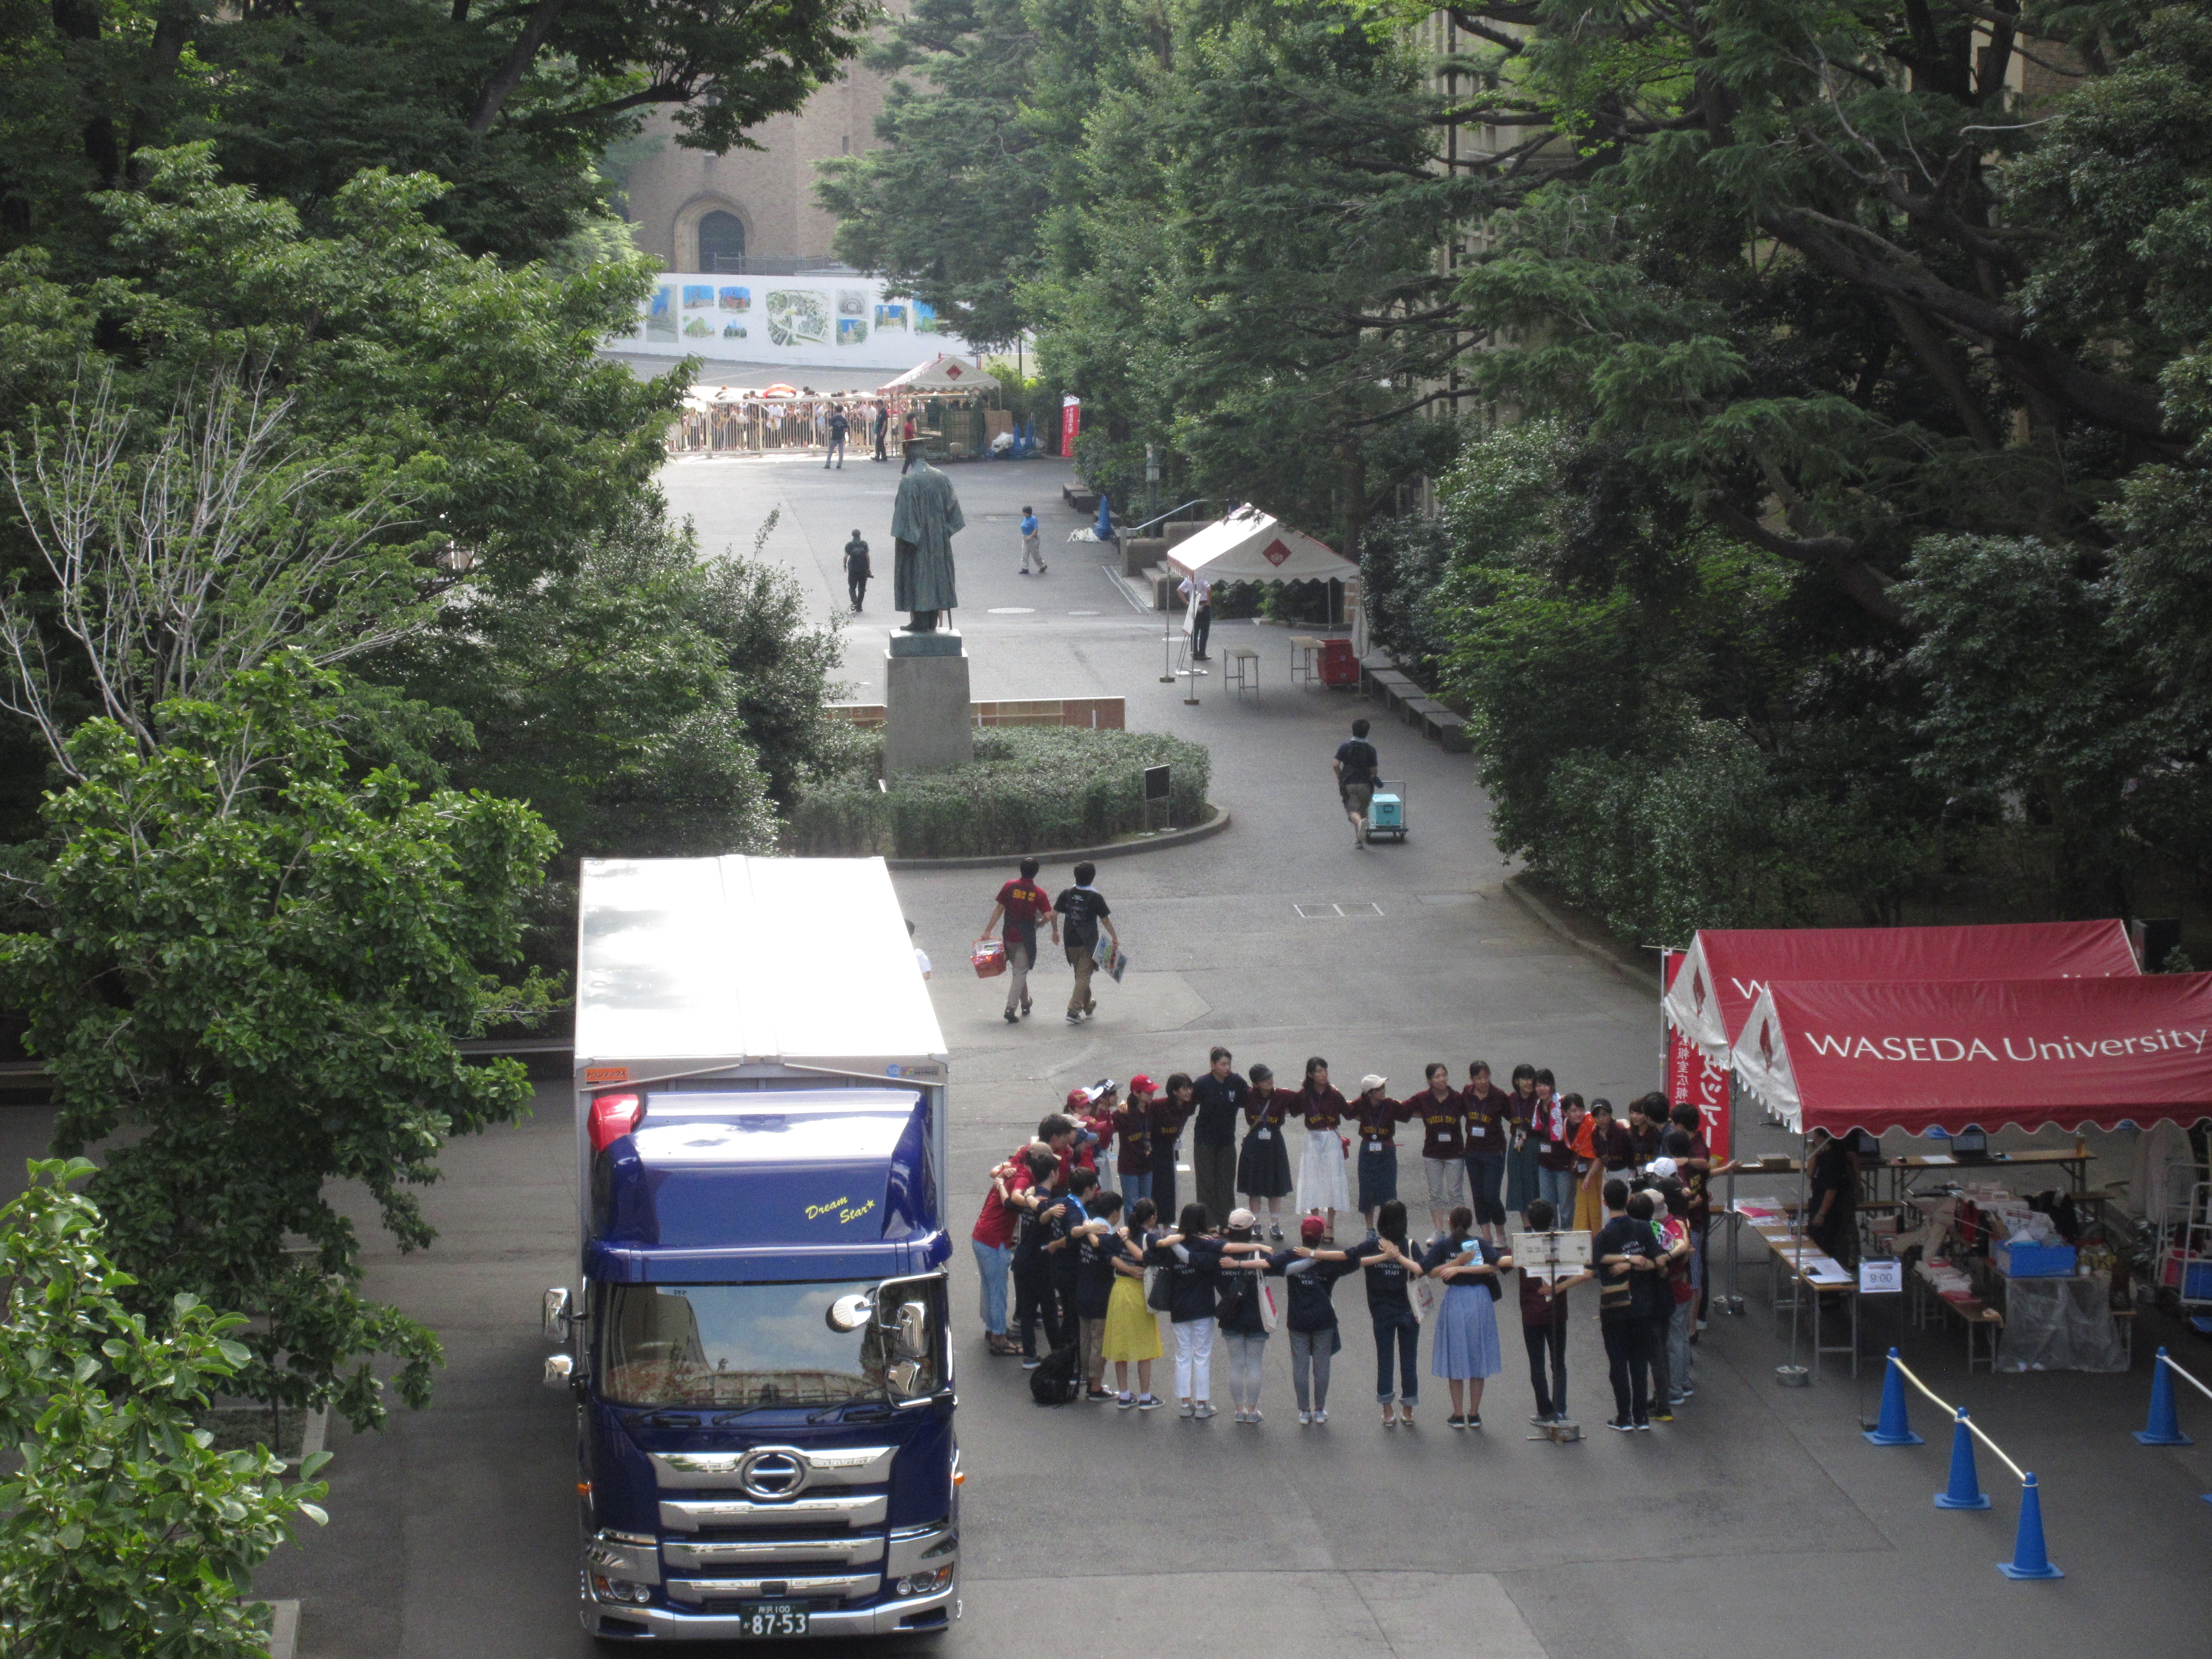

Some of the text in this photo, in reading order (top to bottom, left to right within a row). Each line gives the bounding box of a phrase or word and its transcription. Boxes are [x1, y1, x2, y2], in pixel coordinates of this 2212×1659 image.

[1805, 1029, 2207, 1061] WASEDA University
[805, 1196, 848, 1219] Dream
[840, 1206, 868, 1223] Star
[752, 1613, 806, 1635] 87-53
